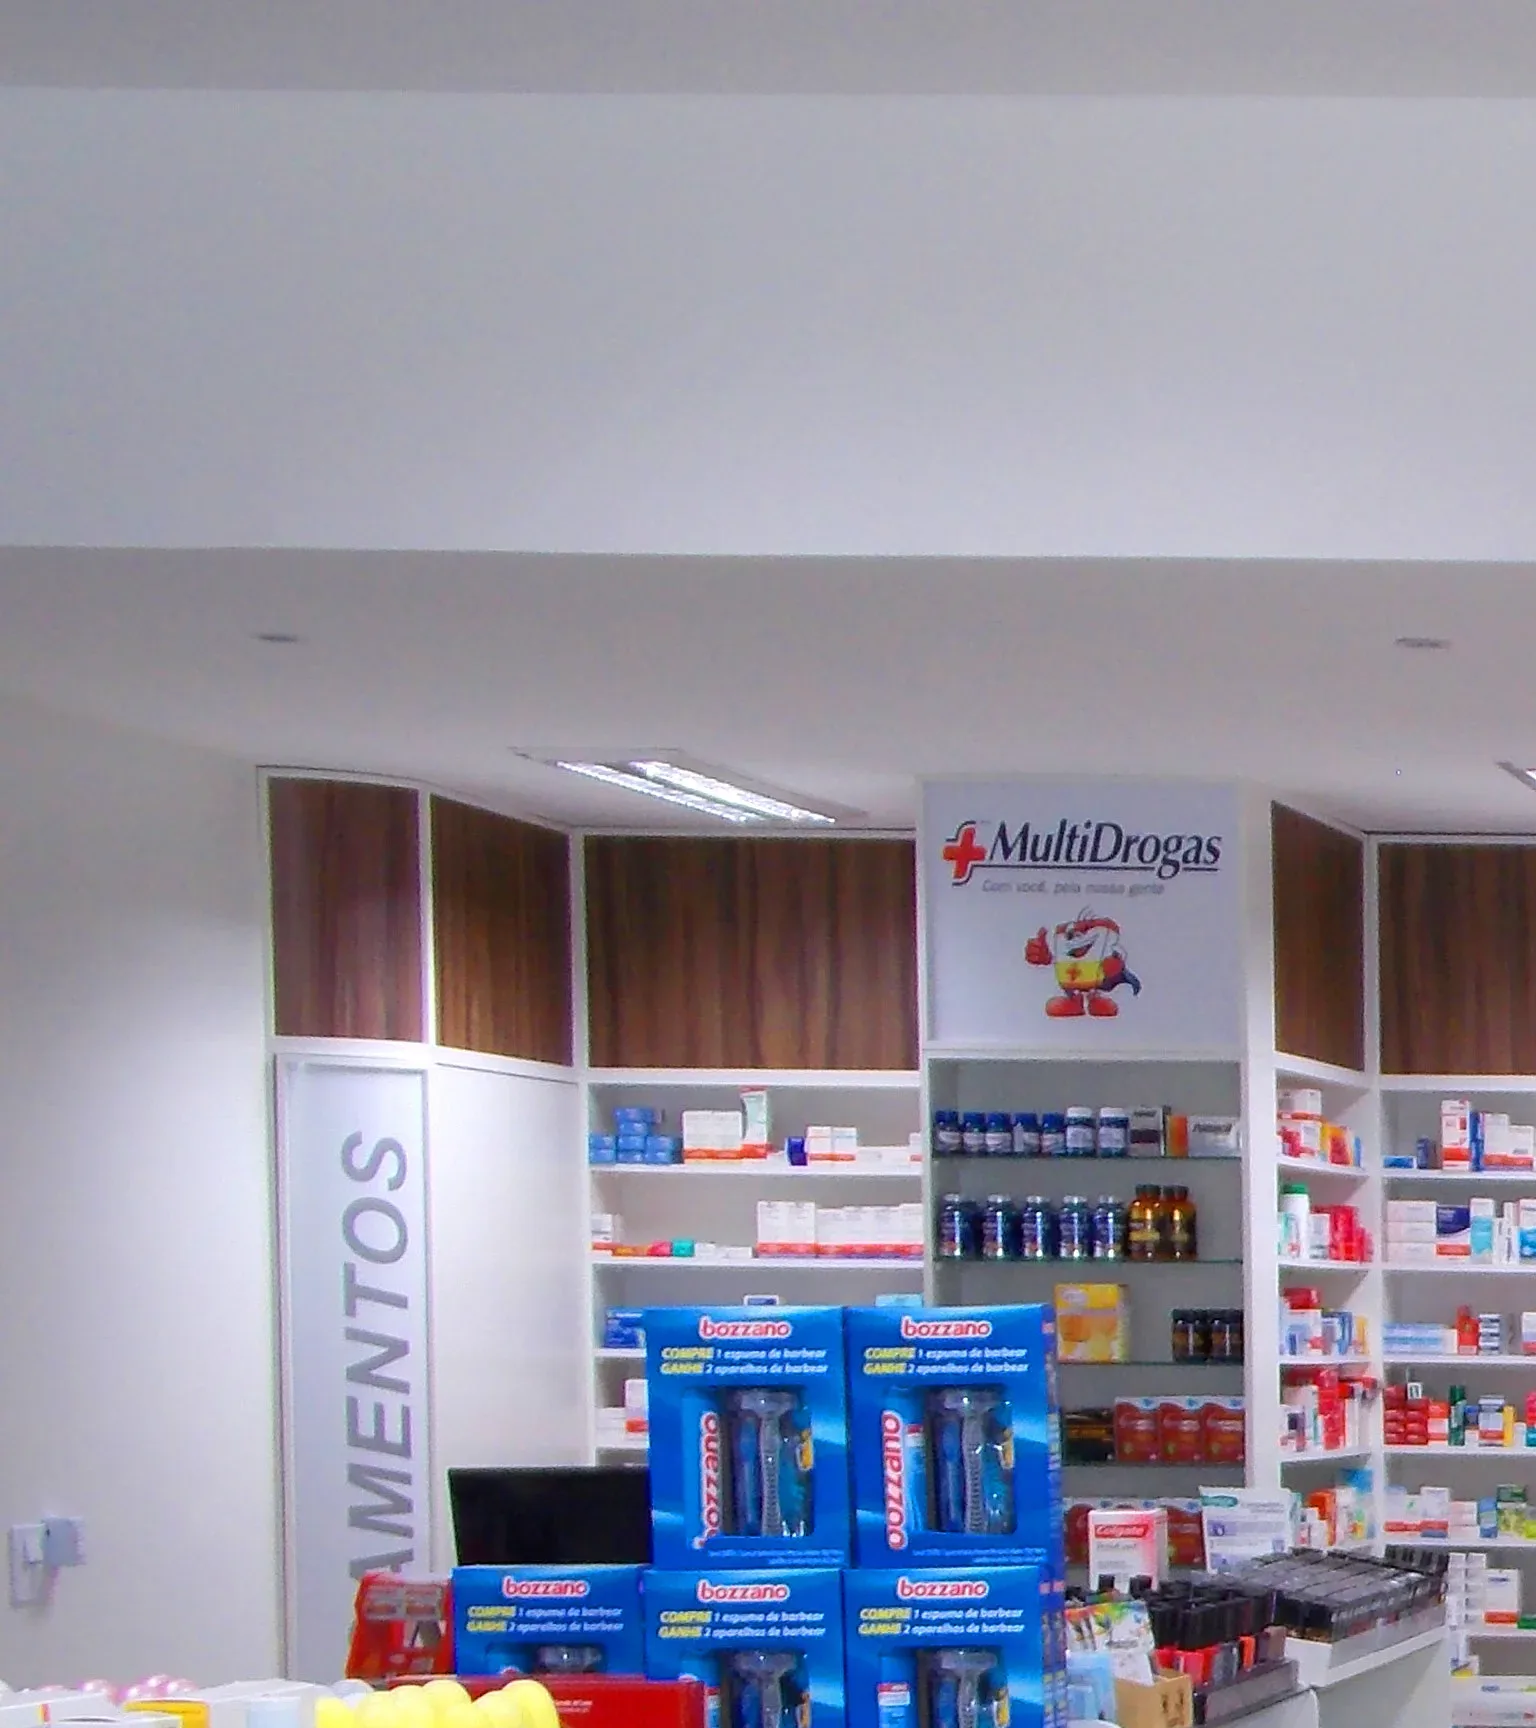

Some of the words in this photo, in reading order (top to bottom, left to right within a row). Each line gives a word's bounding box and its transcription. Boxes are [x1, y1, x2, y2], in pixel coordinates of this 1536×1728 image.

[986, 818, 1223, 880] MultiDrogas
[699, 1315, 792, 1338] bozzano
[901, 1315, 993, 1338] bozzano
[502, 1575, 590, 1598] bozzano
[697, 1579, 790, 1602] bozzano
[897, 1577, 989, 1600] bozzano
